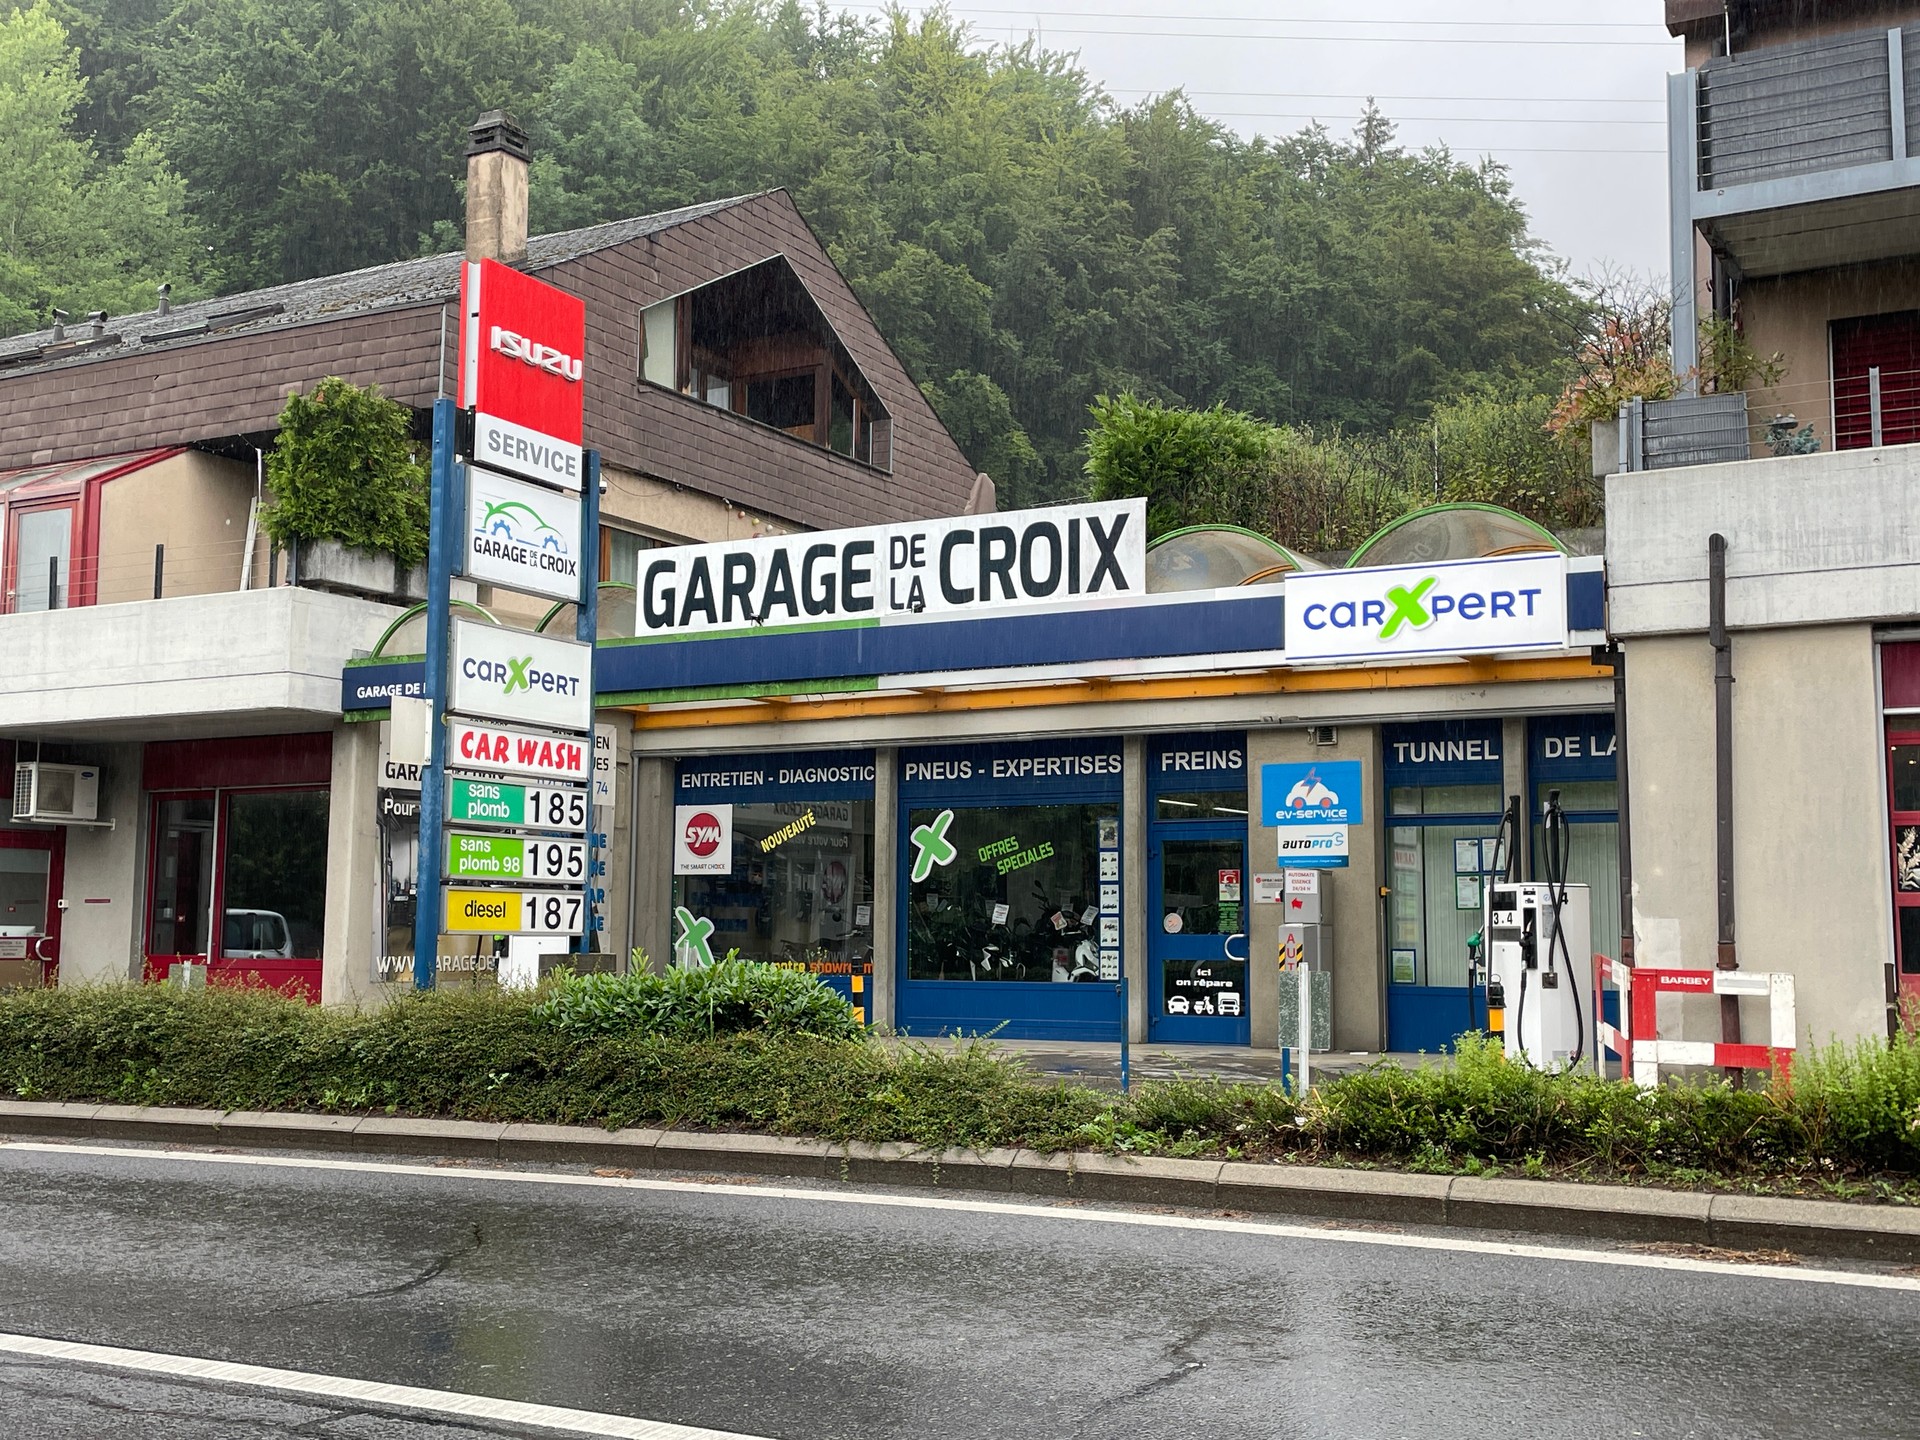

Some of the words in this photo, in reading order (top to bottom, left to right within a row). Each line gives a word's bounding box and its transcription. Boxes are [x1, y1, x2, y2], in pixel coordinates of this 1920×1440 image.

[490, 326, 582, 382] ISUZU
[488, 429, 576, 478] SERVICE
[474, 536, 527, 564] GARAGE
[529, 550, 538, 559] DE
[890, 533, 926, 571] DE
[939, 513, 1130, 604] CROIX
[529, 559, 538, 567] LA
[540, 553, 576, 577] CROIX
[643, 540, 875, 629] GARAGE
[890, 575, 926, 612] LA
[357, 684, 402, 698] GARAGE
[405, 683, 420, 694] DE
[460, 731, 509, 763] CAR
[517, 738, 581, 771] WASH
[1394, 740, 1499, 762] TUNNEL
[1545, 736, 1581, 758] DE
[905, 761, 972, 781] PNEUS
[993, 755, 1122, 777] EXPERTISES
[1161, 750, 1242, 771] FREINS
[681, 771, 763, 788] ENTRETIEN
[779, 766, 874, 784] DIAGNOSTIC
[468, 783, 500, 799] sans
[384, 798, 415, 816] Pour
[467, 800, 510, 818] plomb
[530, 791, 584, 825] 185
[1275, 809, 1347, 819] ev-service
[685, 826, 721, 848] SYM
[760, 808, 816, 853] NOUVEAUTÉ
[460, 839, 491, 852] sans
[978, 836, 1019, 862] OFFRES
[459, 855, 500, 873] plomb
[503, 857, 520, 873] 98
[528, 843, 583, 877] 195
[996, 841, 1054, 875] SPECIALES
[464, 900, 506, 918] diesel
[526, 897, 581, 929] 187
[810, 961, 873, 974] showrm
[1193, 979, 1233, 988] répare
[1660, 976, 1710, 985] BARBEY
